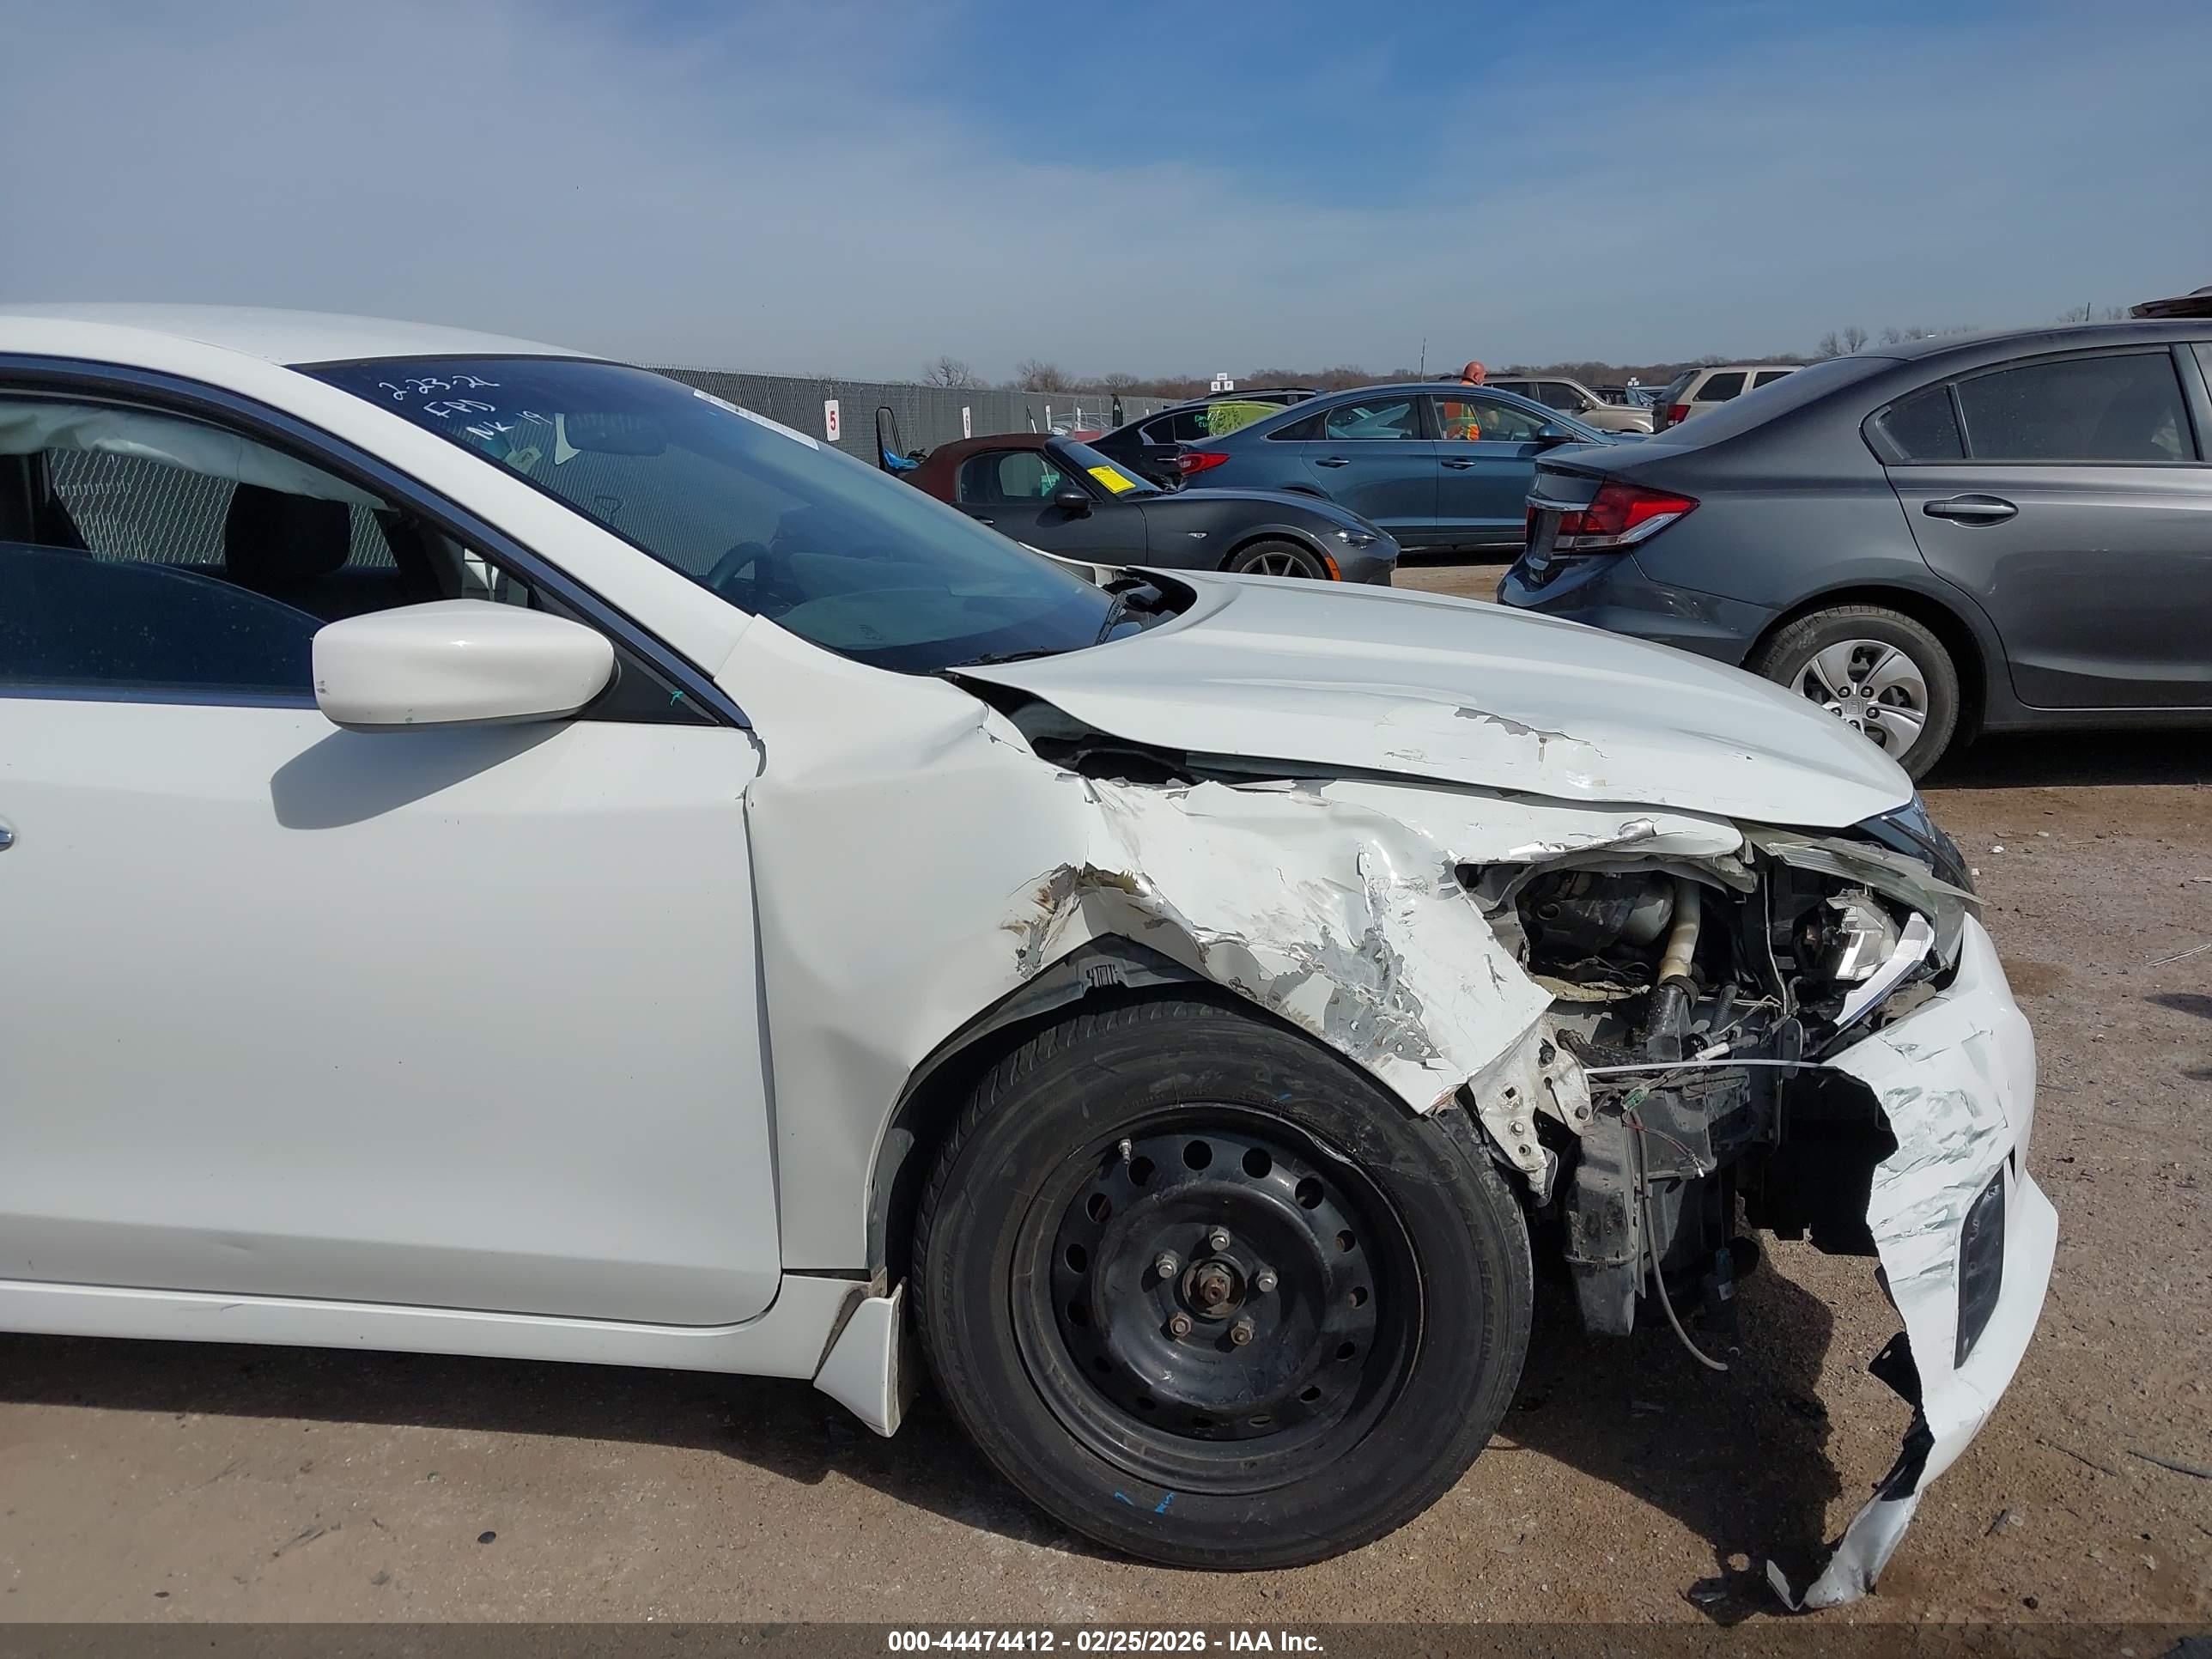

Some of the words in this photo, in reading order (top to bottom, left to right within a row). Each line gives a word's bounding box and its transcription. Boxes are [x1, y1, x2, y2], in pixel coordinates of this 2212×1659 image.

[466, 422, 514, 441] NK
[515, 410, 553, 424] 19
[830, 410, 836, 431] 5
[965, 414, 969, 431] 6
